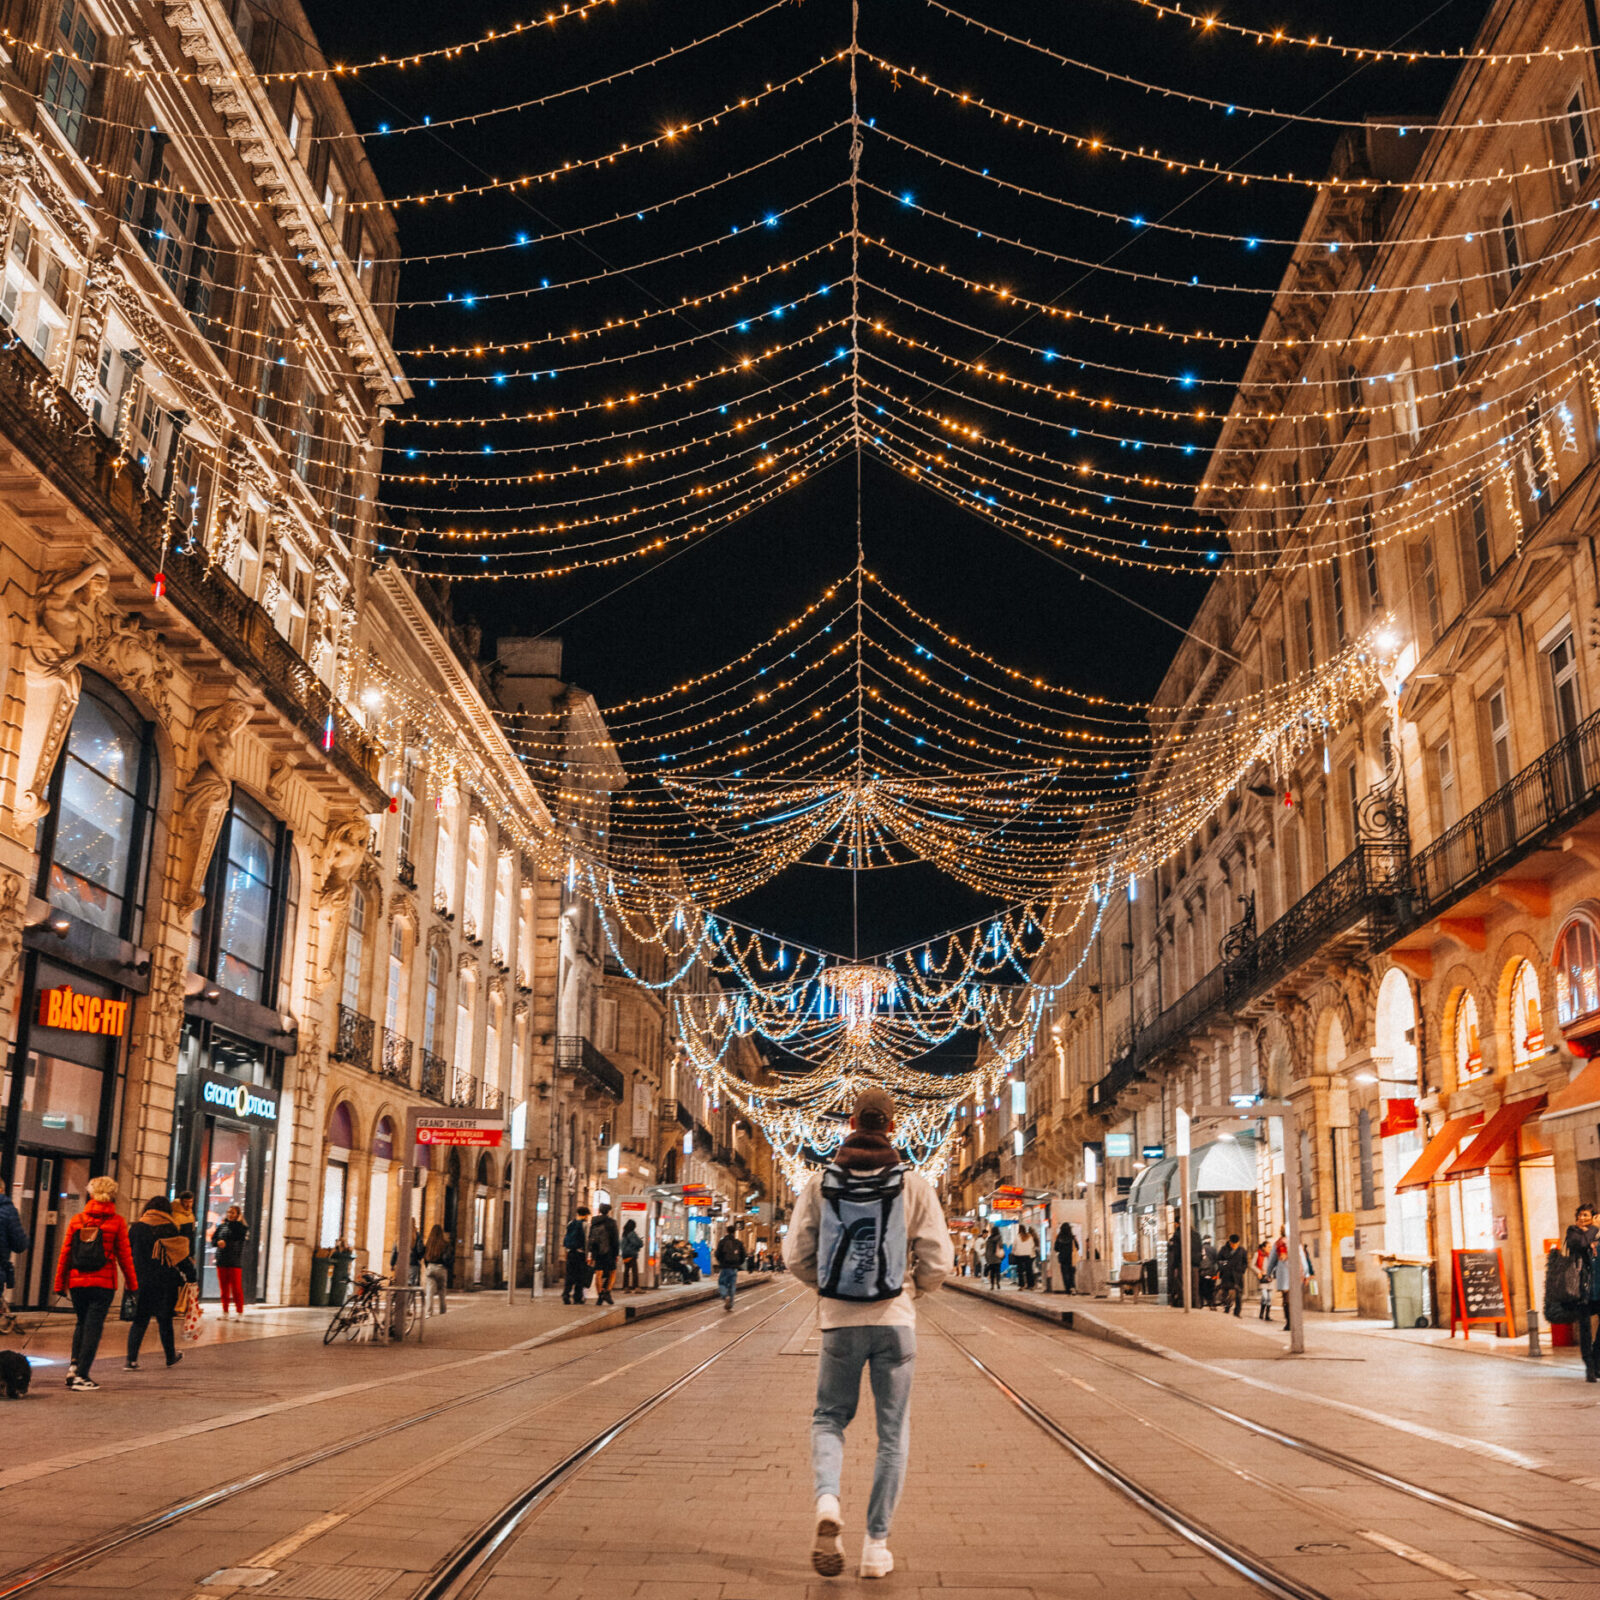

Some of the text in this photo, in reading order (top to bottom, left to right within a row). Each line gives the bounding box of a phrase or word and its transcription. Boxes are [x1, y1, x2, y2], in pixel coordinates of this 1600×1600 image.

[47, 987, 128, 1037] BASIC-FIT
[418, 1119, 477, 1129] GRAND THEATRE
